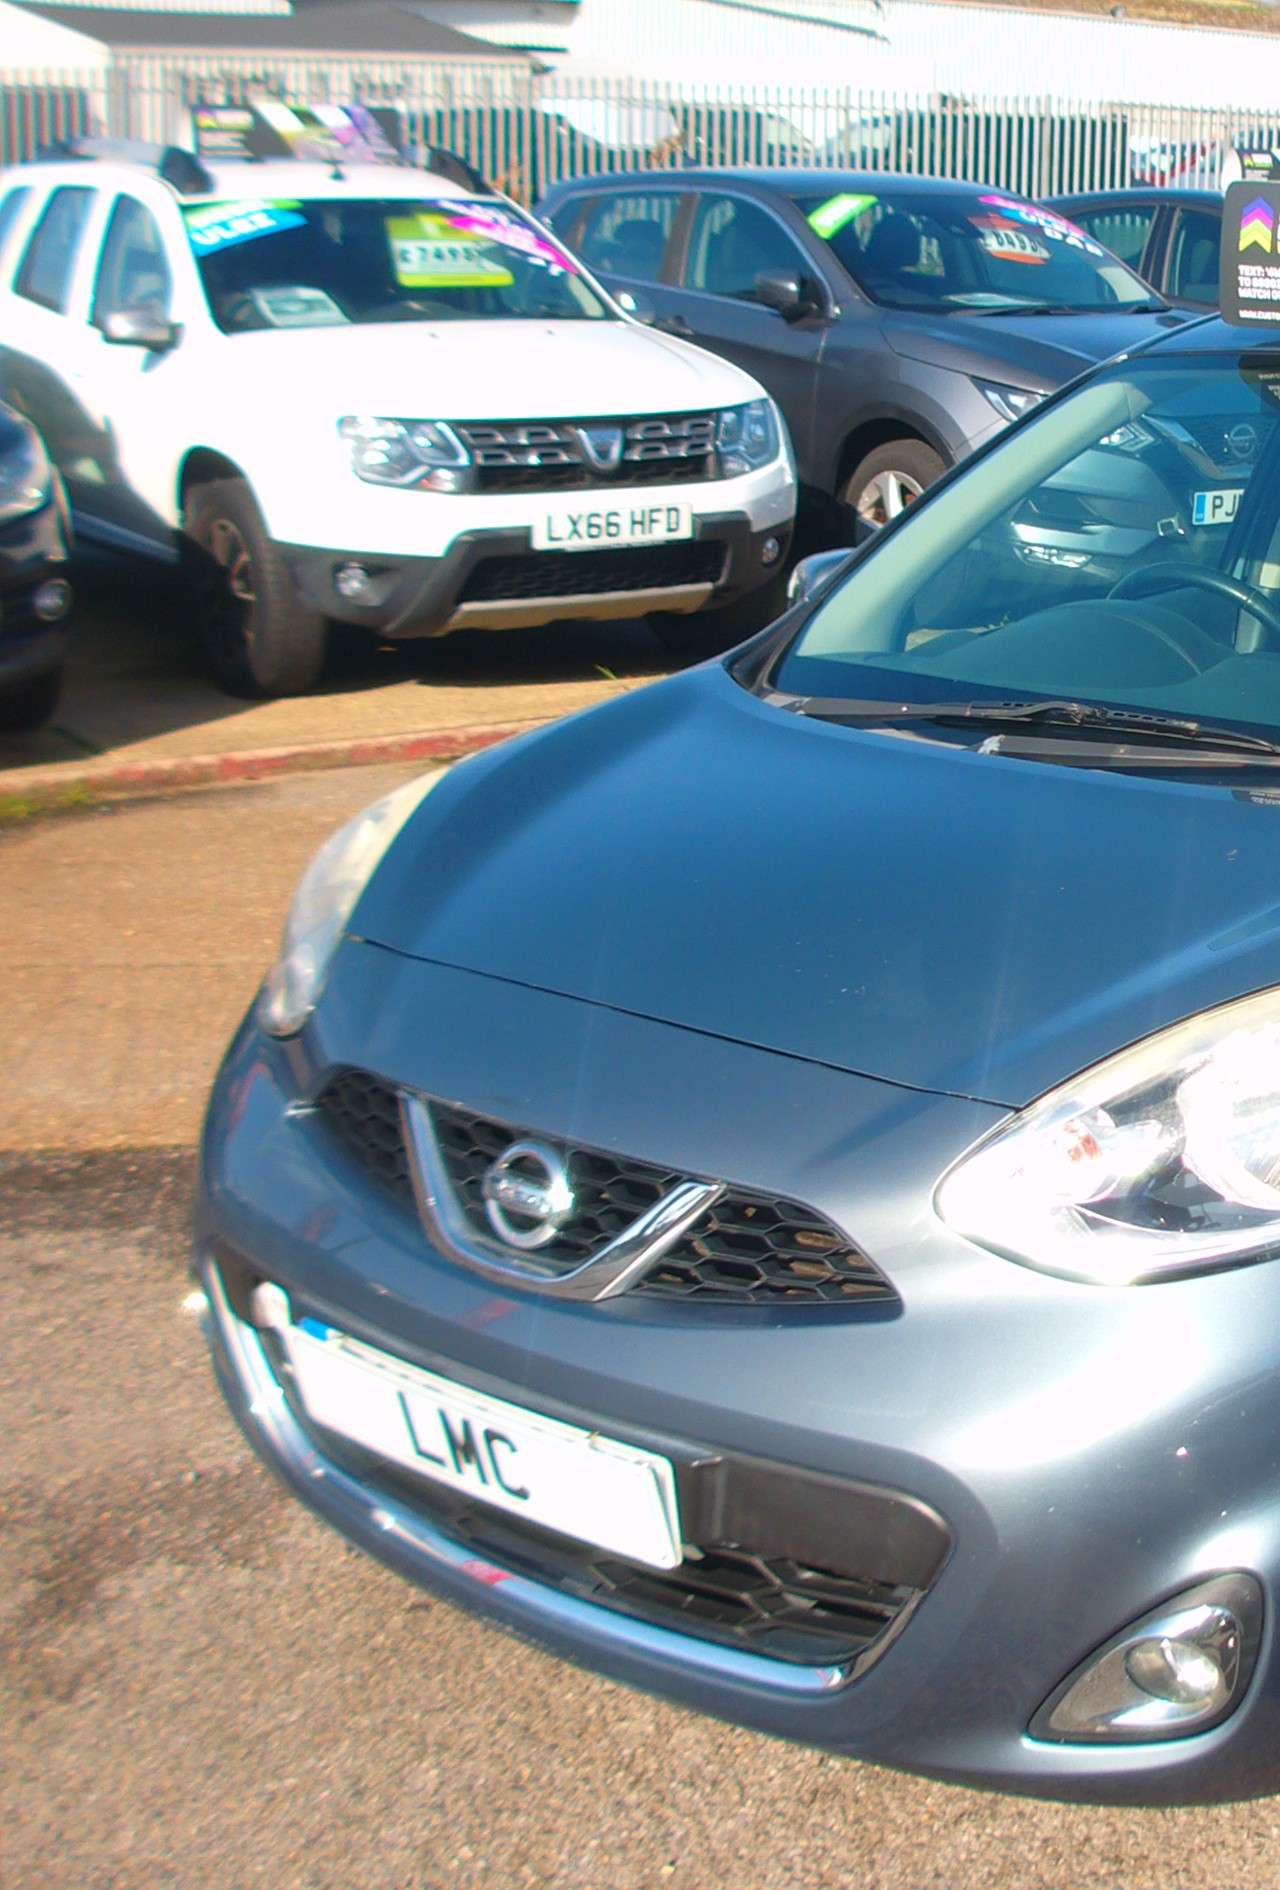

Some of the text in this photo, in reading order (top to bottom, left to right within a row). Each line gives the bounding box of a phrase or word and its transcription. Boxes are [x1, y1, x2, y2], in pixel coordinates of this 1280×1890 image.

[547, 506, 681, 542] LX66 HFD
[398, 1391, 531, 1501] LMC
